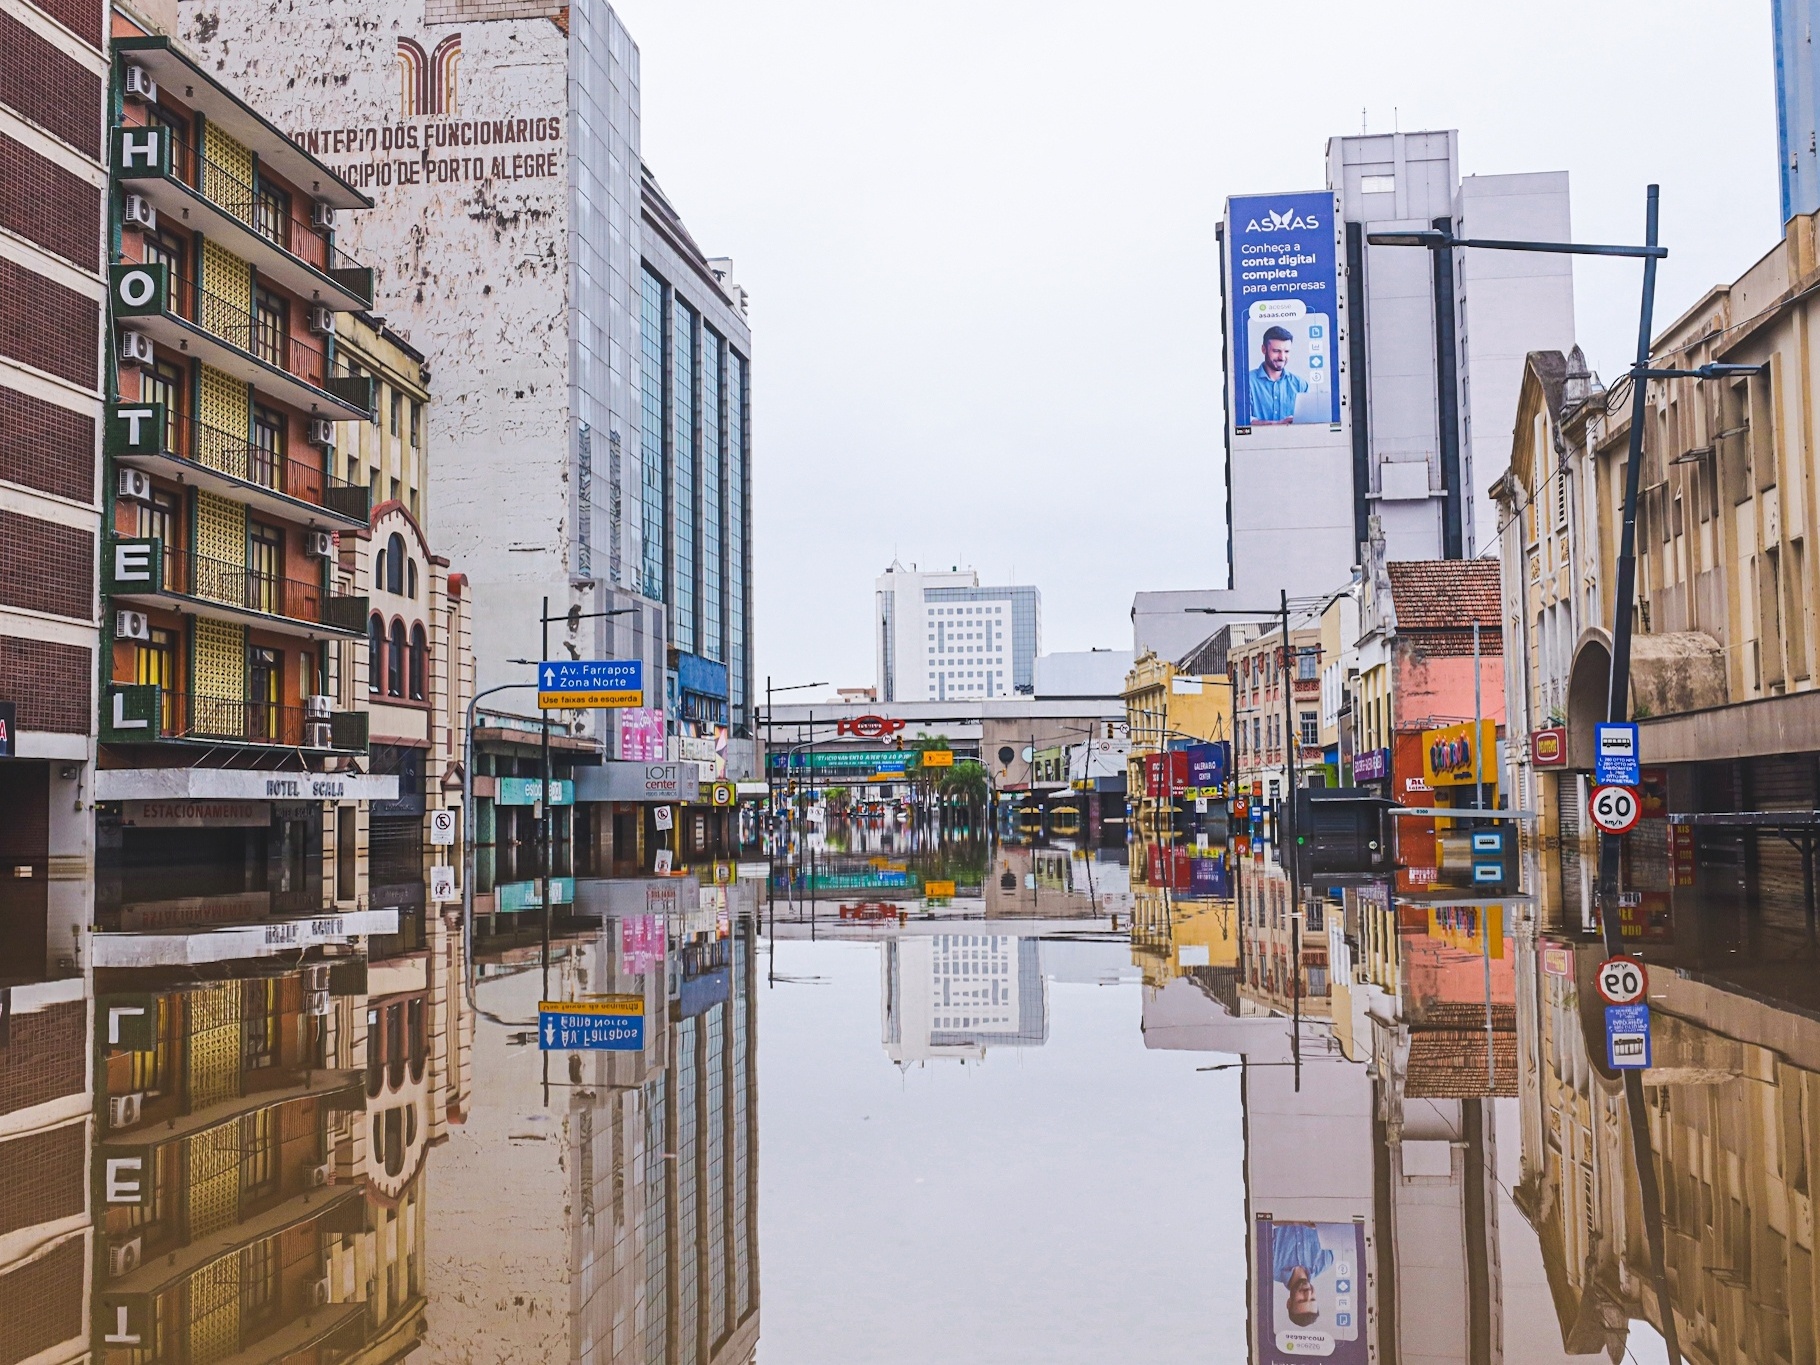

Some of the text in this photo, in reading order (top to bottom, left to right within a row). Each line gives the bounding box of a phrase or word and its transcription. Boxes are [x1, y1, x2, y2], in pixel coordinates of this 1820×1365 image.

[382, 124, 418, 151] DOS
[424, 116, 560, 148] FUNCIONÁRIOS
[397, 159, 420, 185] DE
[426, 156, 484, 184] PORTO
[491, 152, 558, 181] ALEGRE
[1245, 213, 1319, 233] ASAAS
[1241, 243, 1301, 254] Conheça a
[1241, 253, 1316, 267] conta digital
[1242, 269, 1298, 281] completa
[1243, 281, 1326, 295] para empresas
[560, 665, 636, 676] Av. Farrapos
[560, 677, 627, 688] Zona Norte
[543, 696, 558, 704] Use
[588, 695, 599, 703] da
[600, 695, 638, 704] esquerda
[645, 766, 676, 780] LOFT
[266, 780, 344, 797] HOTEL SCALA
[645, 780, 677, 790] center
[143, 804, 253, 819] ESTACIONAMENTO
[1598, 795, 1631, 817] 60
